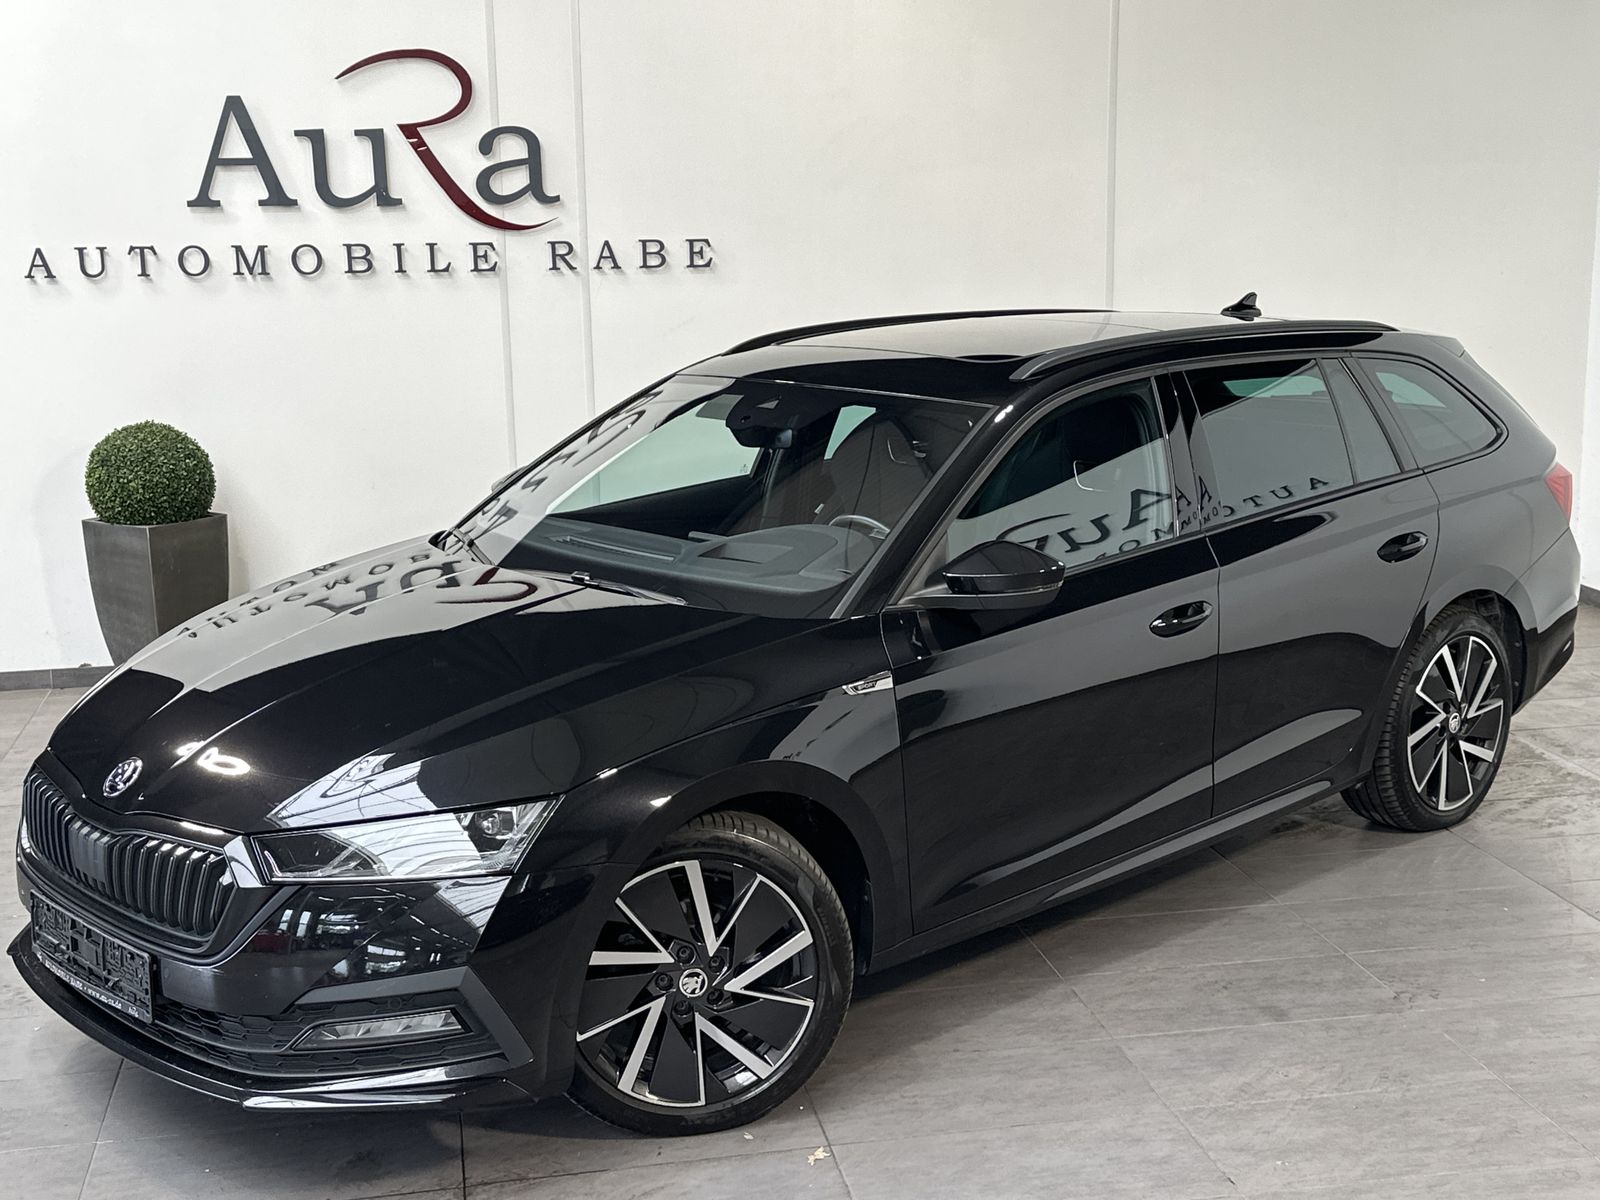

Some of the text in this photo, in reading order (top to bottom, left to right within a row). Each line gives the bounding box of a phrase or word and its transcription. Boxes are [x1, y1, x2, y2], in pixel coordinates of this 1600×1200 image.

[187, 48, 560, 231] AuRa
[25, 238, 715, 280] AUTOMOBILE RABE
